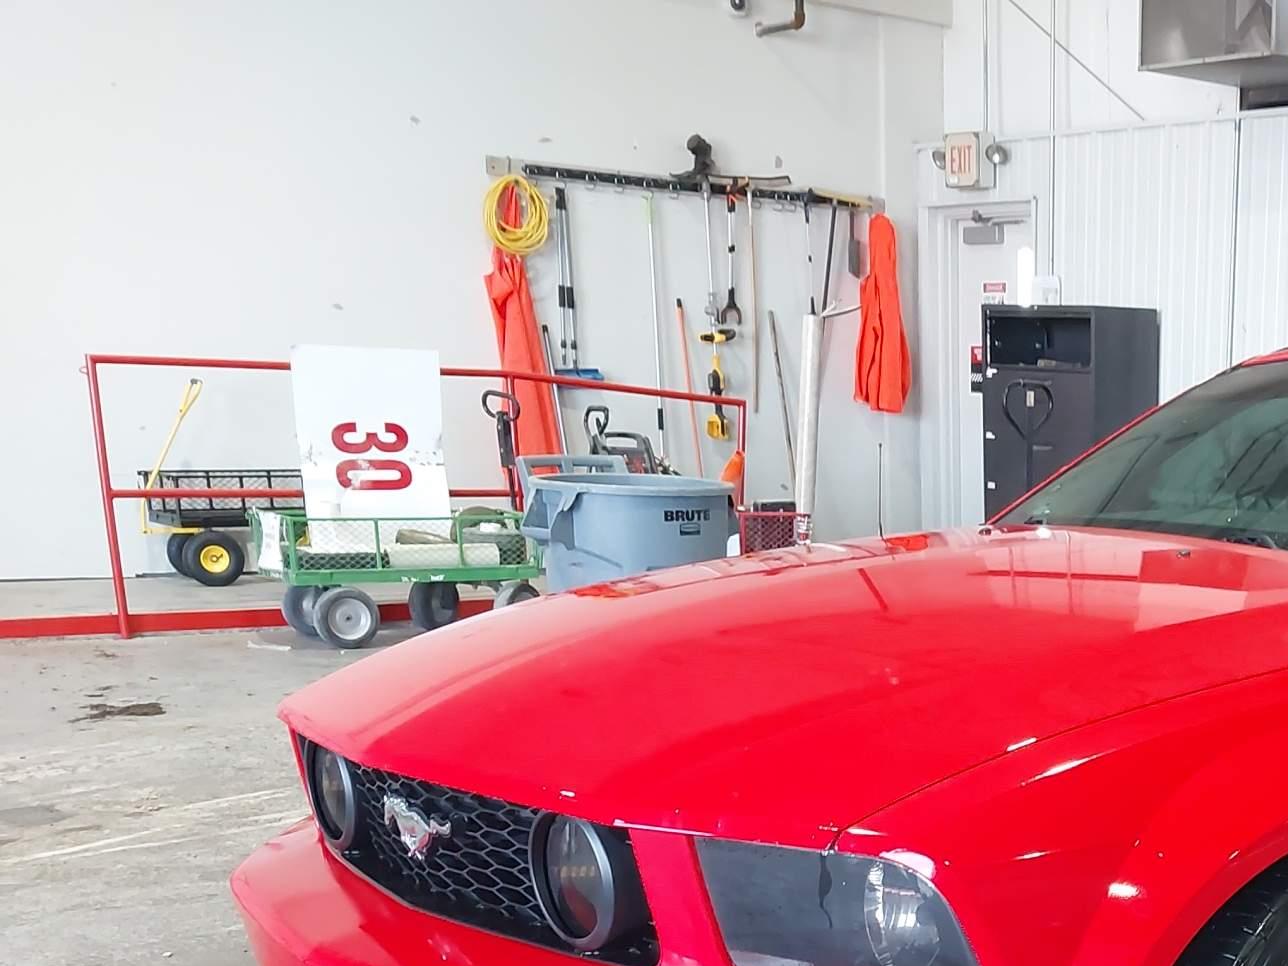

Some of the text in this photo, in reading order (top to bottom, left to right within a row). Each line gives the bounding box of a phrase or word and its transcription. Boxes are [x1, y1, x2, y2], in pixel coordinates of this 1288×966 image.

[950, 145, 972, 175] EXIT
[331, 422, 412, 490] 30
[663, 509, 711, 522] BRUTE
